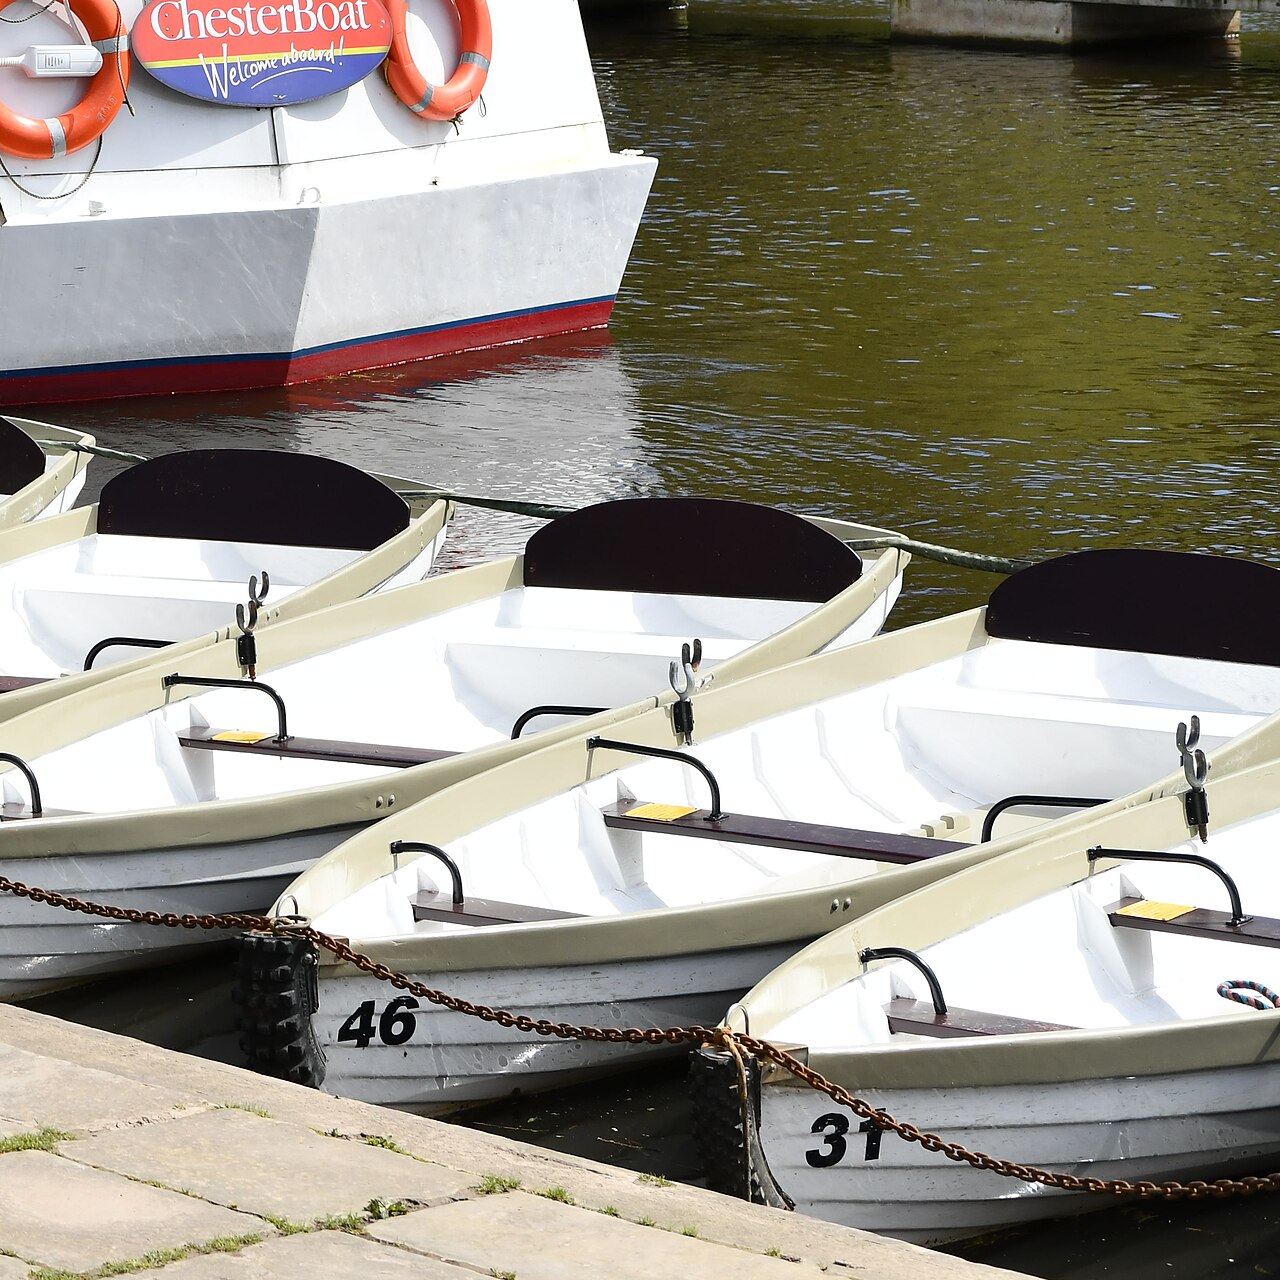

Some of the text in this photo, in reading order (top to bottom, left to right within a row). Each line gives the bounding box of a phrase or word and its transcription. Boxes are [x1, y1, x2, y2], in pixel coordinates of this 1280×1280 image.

[198, 35, 345, 99] Welcome aboard!
[338, 996, 421, 1049] 46
[805, 1108, 886, 1169] 31
